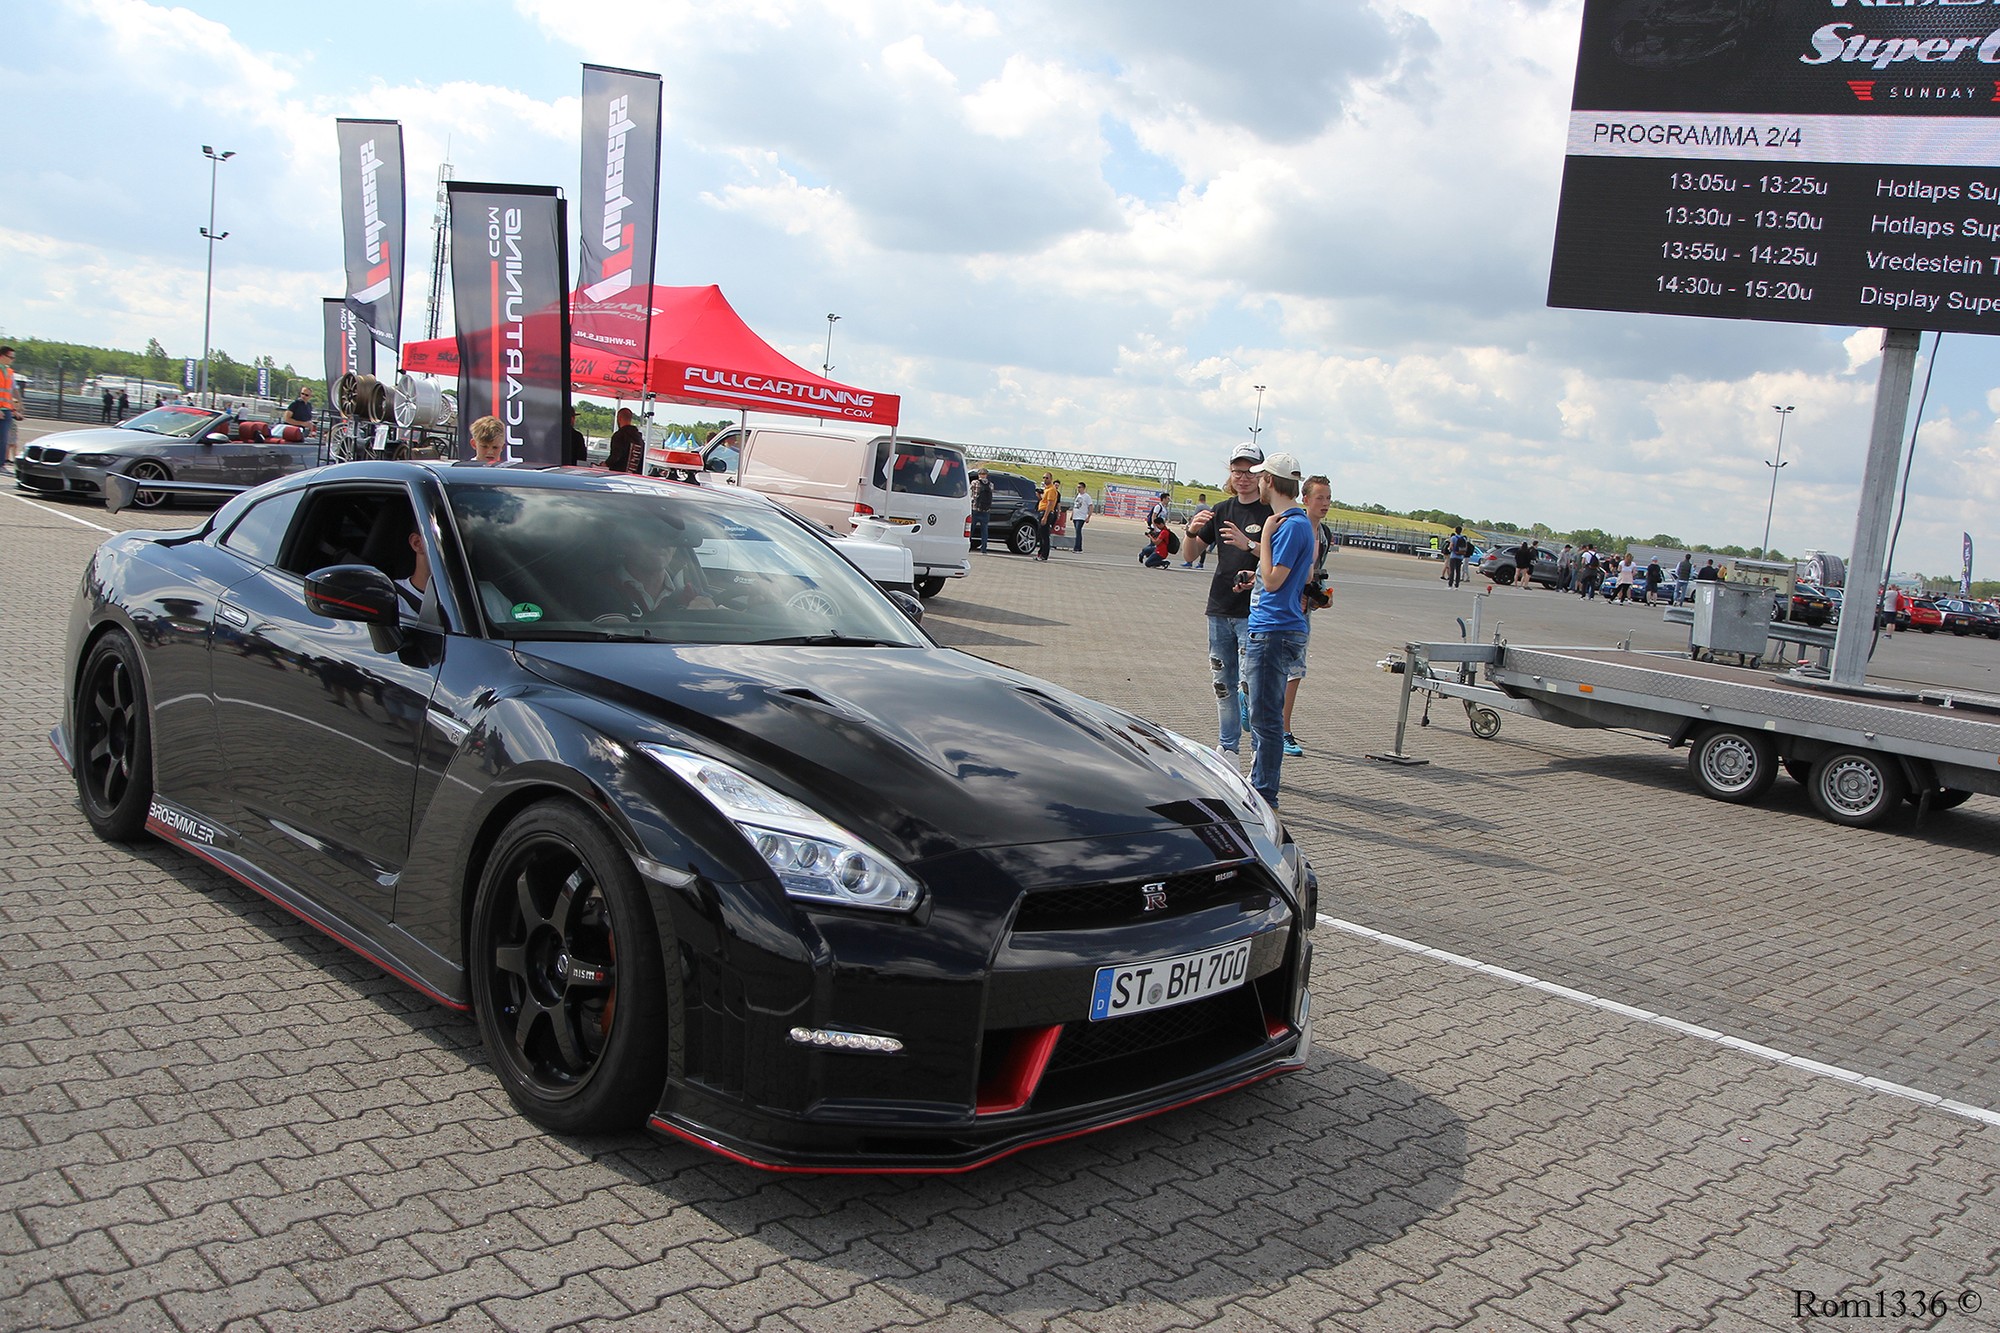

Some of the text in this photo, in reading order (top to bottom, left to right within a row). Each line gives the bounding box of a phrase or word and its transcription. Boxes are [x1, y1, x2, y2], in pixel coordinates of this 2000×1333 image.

[1889, 86, 1976, 99] SUNDAY
[1593, 123, 1802, 148] PROGRAMMA 2/4
[1670, 172, 1737, 192] 13:05u
[1759, 175, 1829, 195] 13:25u
[1876, 179, 1961, 204] Hotlaps
[1967, 181, 2000, 206] Su
[1665, 207, 1732, 227] 13:30u
[1754, 210, 1823, 230] 13:50u
[1871, 214, 1955, 239] Hotlaps
[1660, 241, 1727, 262] 13:55u
[1749, 245, 1818, 267] 14:25u
[1866, 249, 1983, 275] Vredestein
[1655, 275, 1722, 296] 14:30u
[1744, 280, 1813, 301] 15:20u
[1860, 286, 1941, 313] Display
[603, 373, 636, 386] BLOX
[684, 366, 875, 408] FULLCARTUNING
[841, 407, 874, 419] COM
[148, 801, 216, 845] BROEMMLER
[1112, 946, 1248, 1009] ST BH 700
[1096, 999, 1105, 1011] D
